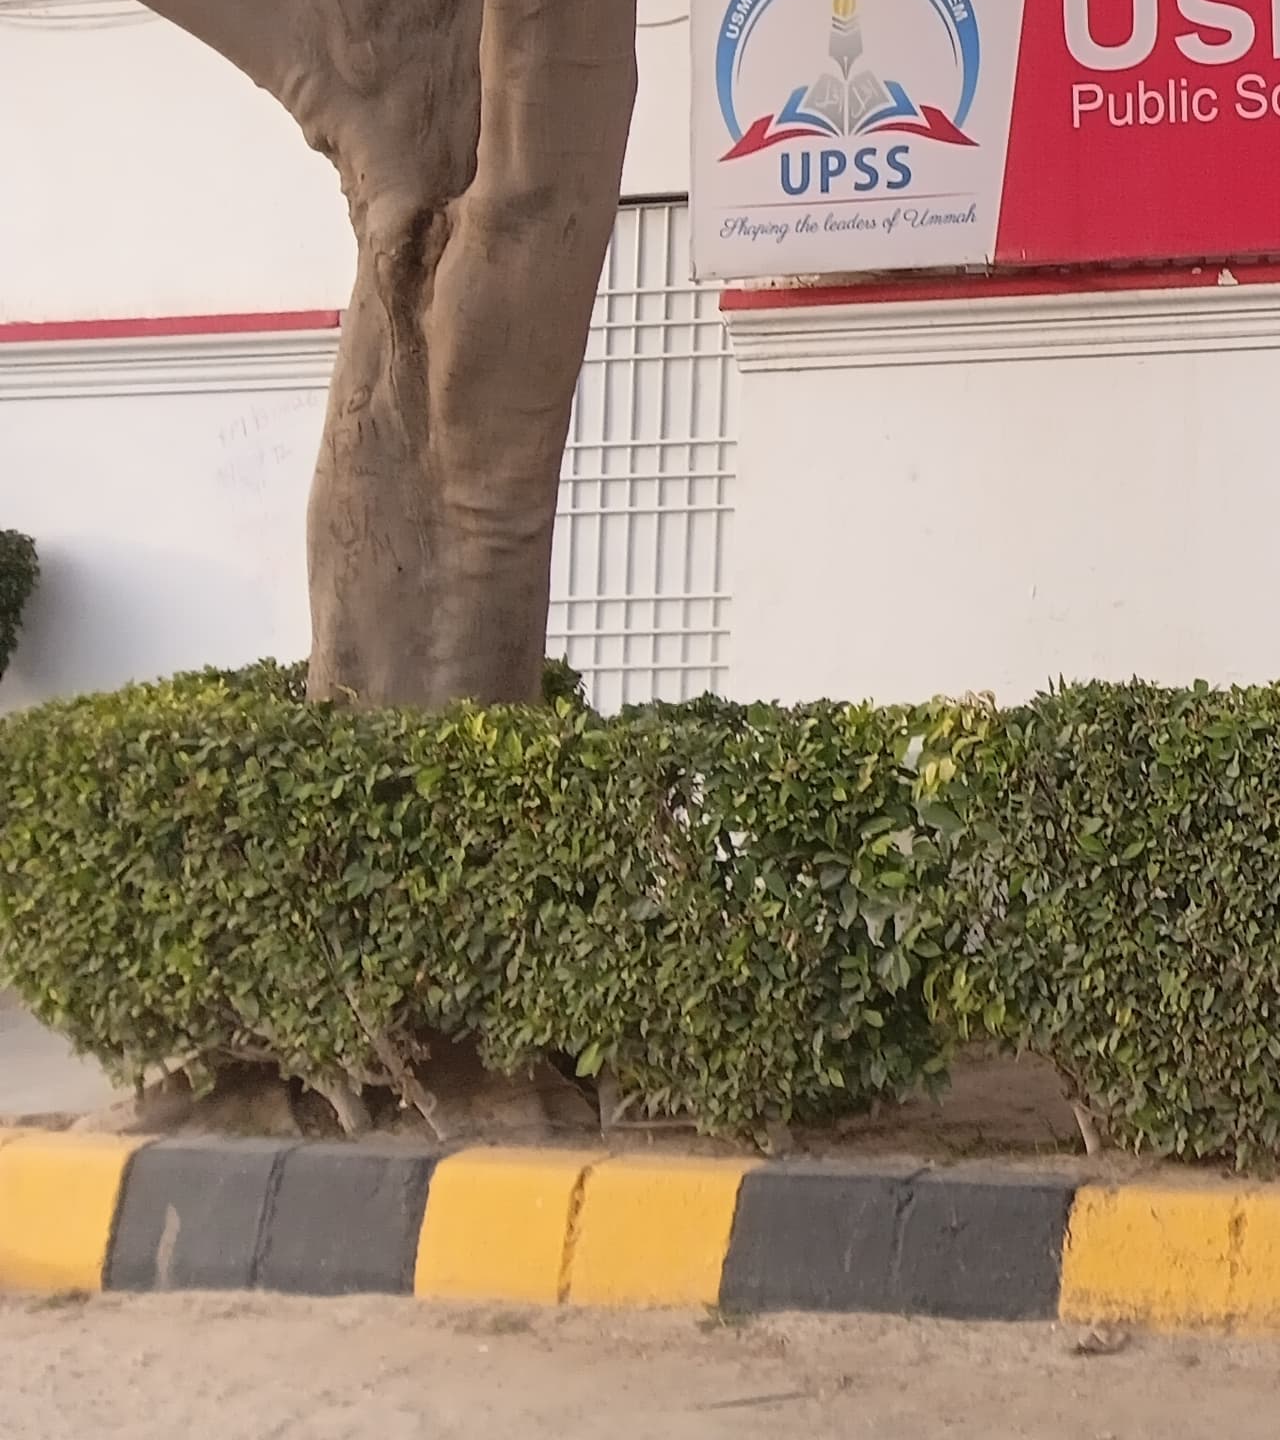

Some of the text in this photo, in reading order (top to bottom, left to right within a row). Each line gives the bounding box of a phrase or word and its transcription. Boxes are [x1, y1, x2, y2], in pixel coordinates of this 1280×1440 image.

[1071, 79, 1219, 129] Public
[780, 145, 913, 196] UPSS
[719, 203, 977, 244] Shaping the leaders of Ummah
